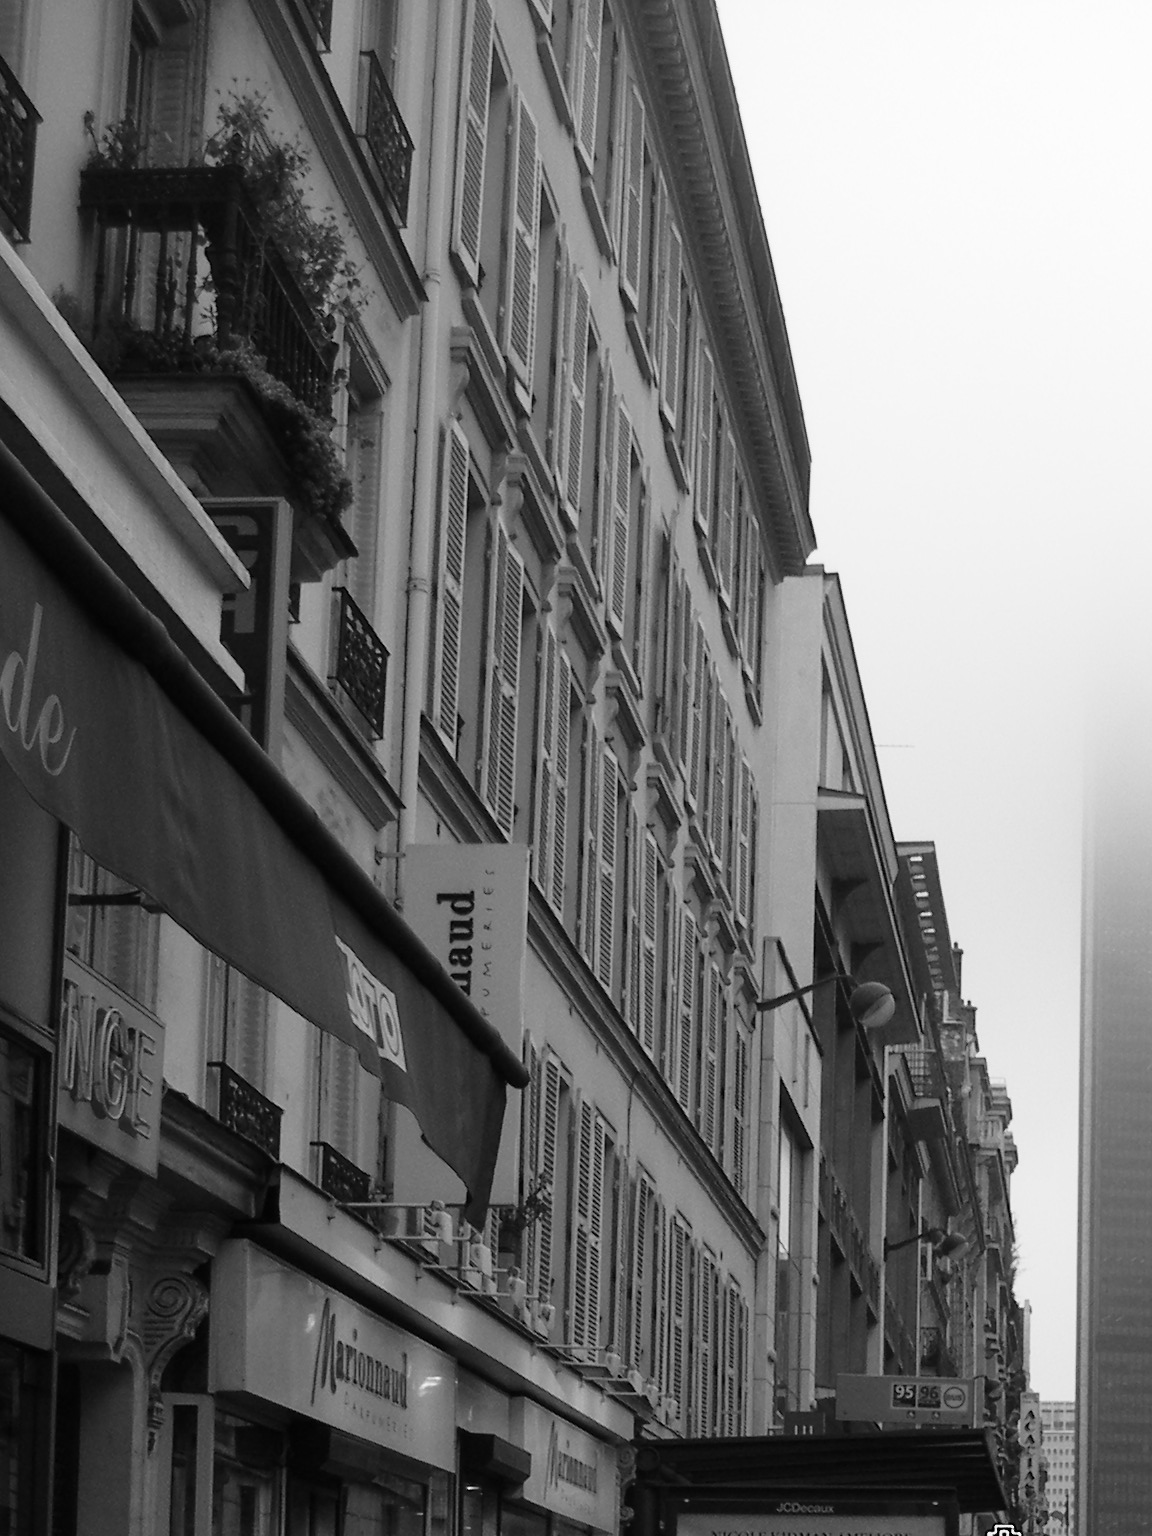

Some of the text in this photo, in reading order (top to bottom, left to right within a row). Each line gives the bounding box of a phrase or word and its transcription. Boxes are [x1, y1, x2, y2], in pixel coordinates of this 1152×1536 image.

[311, 1297, 407, 1409] Marionnaud
[895, 1385, 914, 1399] 95
[920, 1385, 938, 1399] 96
[776, 1502, 835, 1513] JCDecaux
